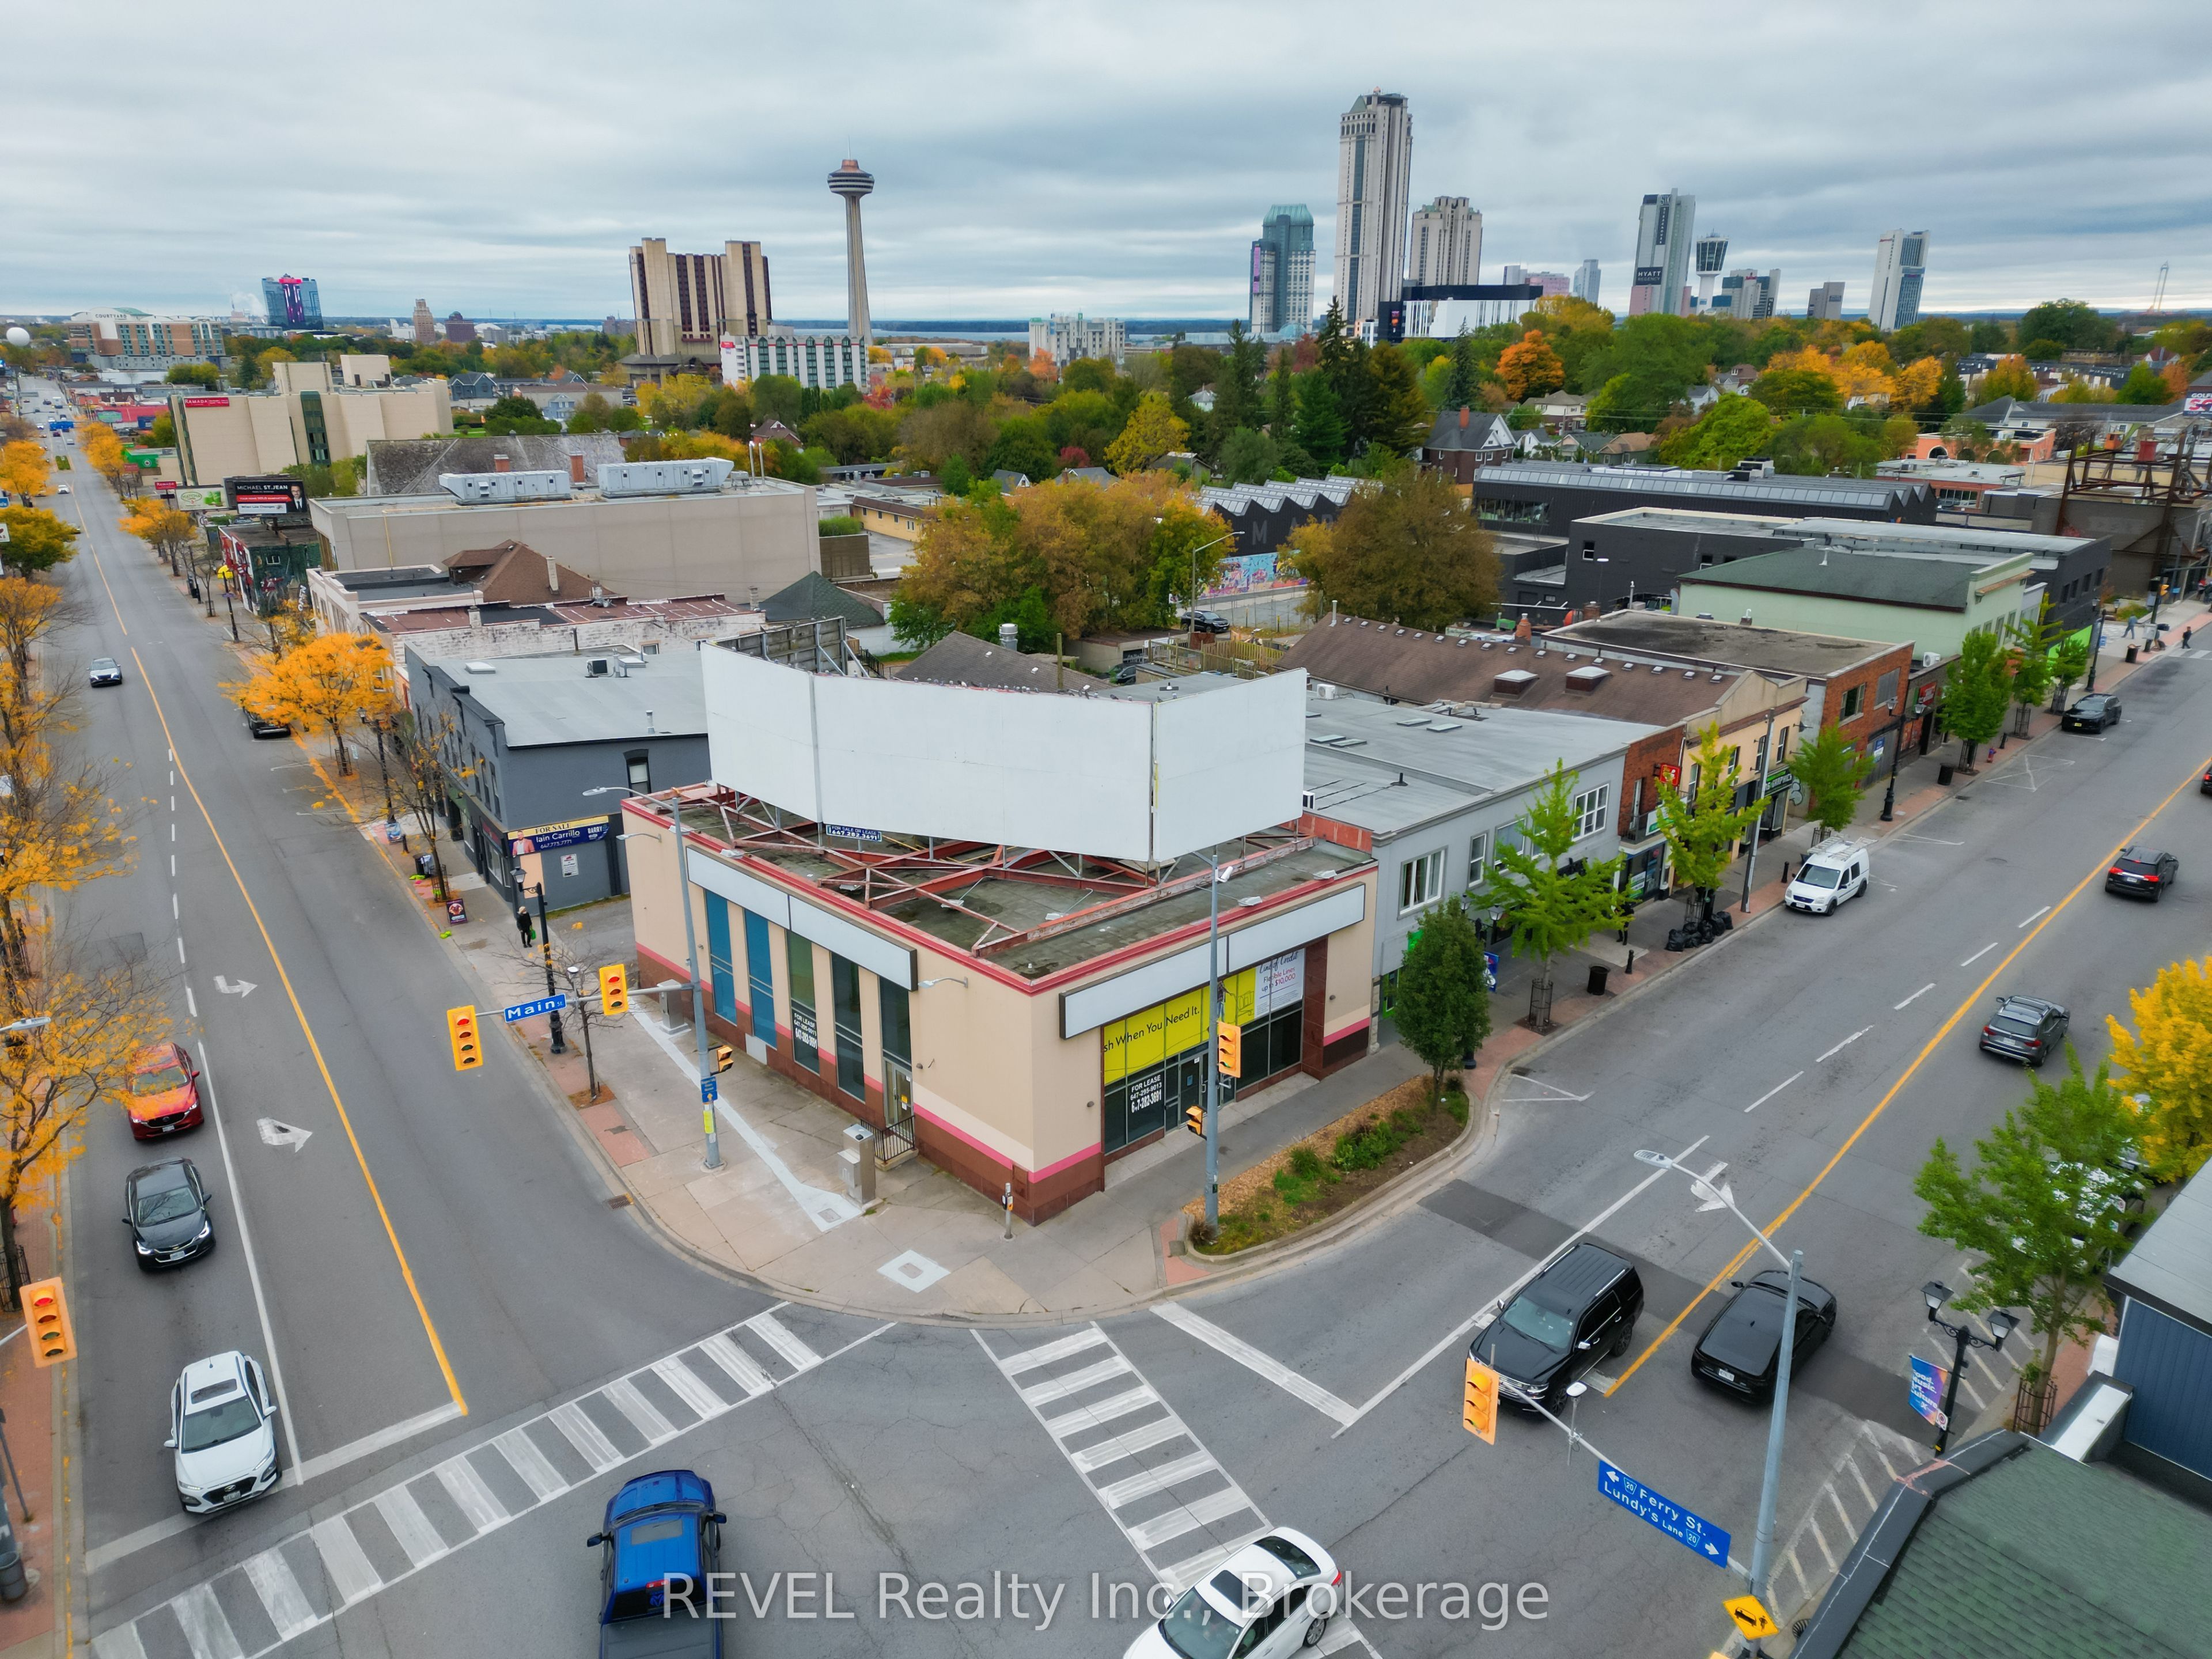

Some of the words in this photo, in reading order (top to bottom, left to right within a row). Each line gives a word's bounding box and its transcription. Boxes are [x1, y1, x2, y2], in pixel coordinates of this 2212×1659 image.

[551, 823, 571, 832] SALE
[552, 830, 580, 840] Carrillo
[1275, 972, 1296, 986] $10,000
[1283, 967, 1296, 975] Lines
[507, 1001, 555, 1019] Main
[794, 1013, 802, 1022] FOR
[1115, 1029, 1144, 1046] When
[1146, 1021, 1162, 1033] You
[1165, 1007, 1190, 1027] Need
[1191, 1006, 1200, 1016] It.
[1130, 1082, 1162, 1101] 647-295-9013
[1131, 1082, 1143, 1093] FOR
[1143, 1074, 1161, 1088] LEASE
[1604, 1481, 1658, 1522] Lundy's
[1662, 1520, 1683, 1538] Lane
[1688, 1533, 1696, 1543] 20
[1626, 1482, 1634, 1491] 20
[1639, 1488, 1679, 1521] Ferry
[1685, 1516, 1706, 1536] St.
